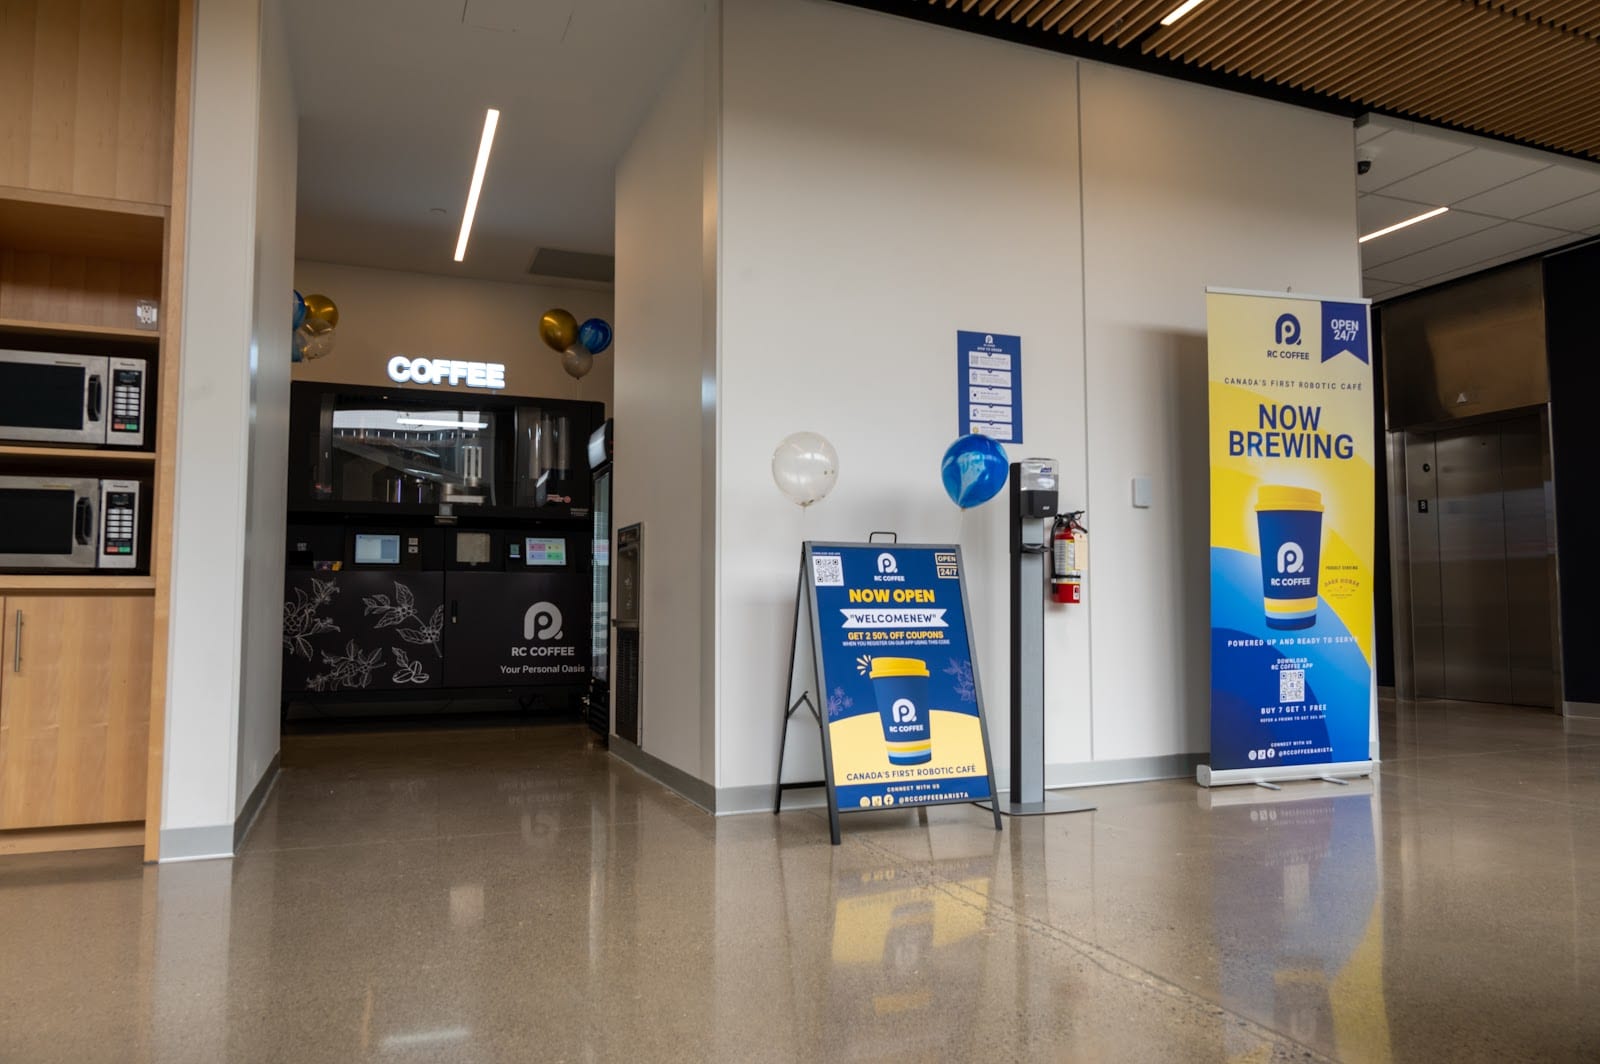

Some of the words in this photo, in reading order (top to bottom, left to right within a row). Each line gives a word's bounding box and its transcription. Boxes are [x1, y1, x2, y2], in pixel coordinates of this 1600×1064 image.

[1331, 319, 1358, 331] OPEN
[1334, 330, 1356, 341] 24/7
[1280, 351, 1309, 360] COFFEE
[388, 356, 505, 389] COFFEE
[1224, 377, 1267, 386] CANADA'S
[1299, 381, 1336, 390] ROBOTIC
[1341, 381, 1362, 390] CAFÉ
[1259, 404, 1321, 431] NOW
[1229, 430, 1353, 459] BREWING
[940, 567, 957, 576] 24/7
[1271, 578, 1280, 586] RC
[1282, 577, 1311, 586] COFFEE
[849, 589, 890, 603] NOW
[893, 589, 935, 603] OPEN
[850, 614, 936, 623] "WELCOMENEW"
[848, 632, 864, 640] GET
[872, 632, 888, 640] 50%
[906, 631, 944, 639] COUPONS
[511, 647, 527, 656] RC
[530, 646, 575, 656] COFFEE
[500, 665, 521, 674] Your
[522, 665, 560, 673] Personal
[561, 664, 585, 672] Oasis
[1278, 747, 1333, 757] @RCCOFFEEBARISTA
[847, 771, 890, 781] CANADA'S
[892, 770, 914, 779] FIRST
[917, 767, 954, 776] ROBOTIC
[956, 765, 976, 773] CAFÉ
[899, 792, 968, 804] @RCCOFFEEBARISTA
